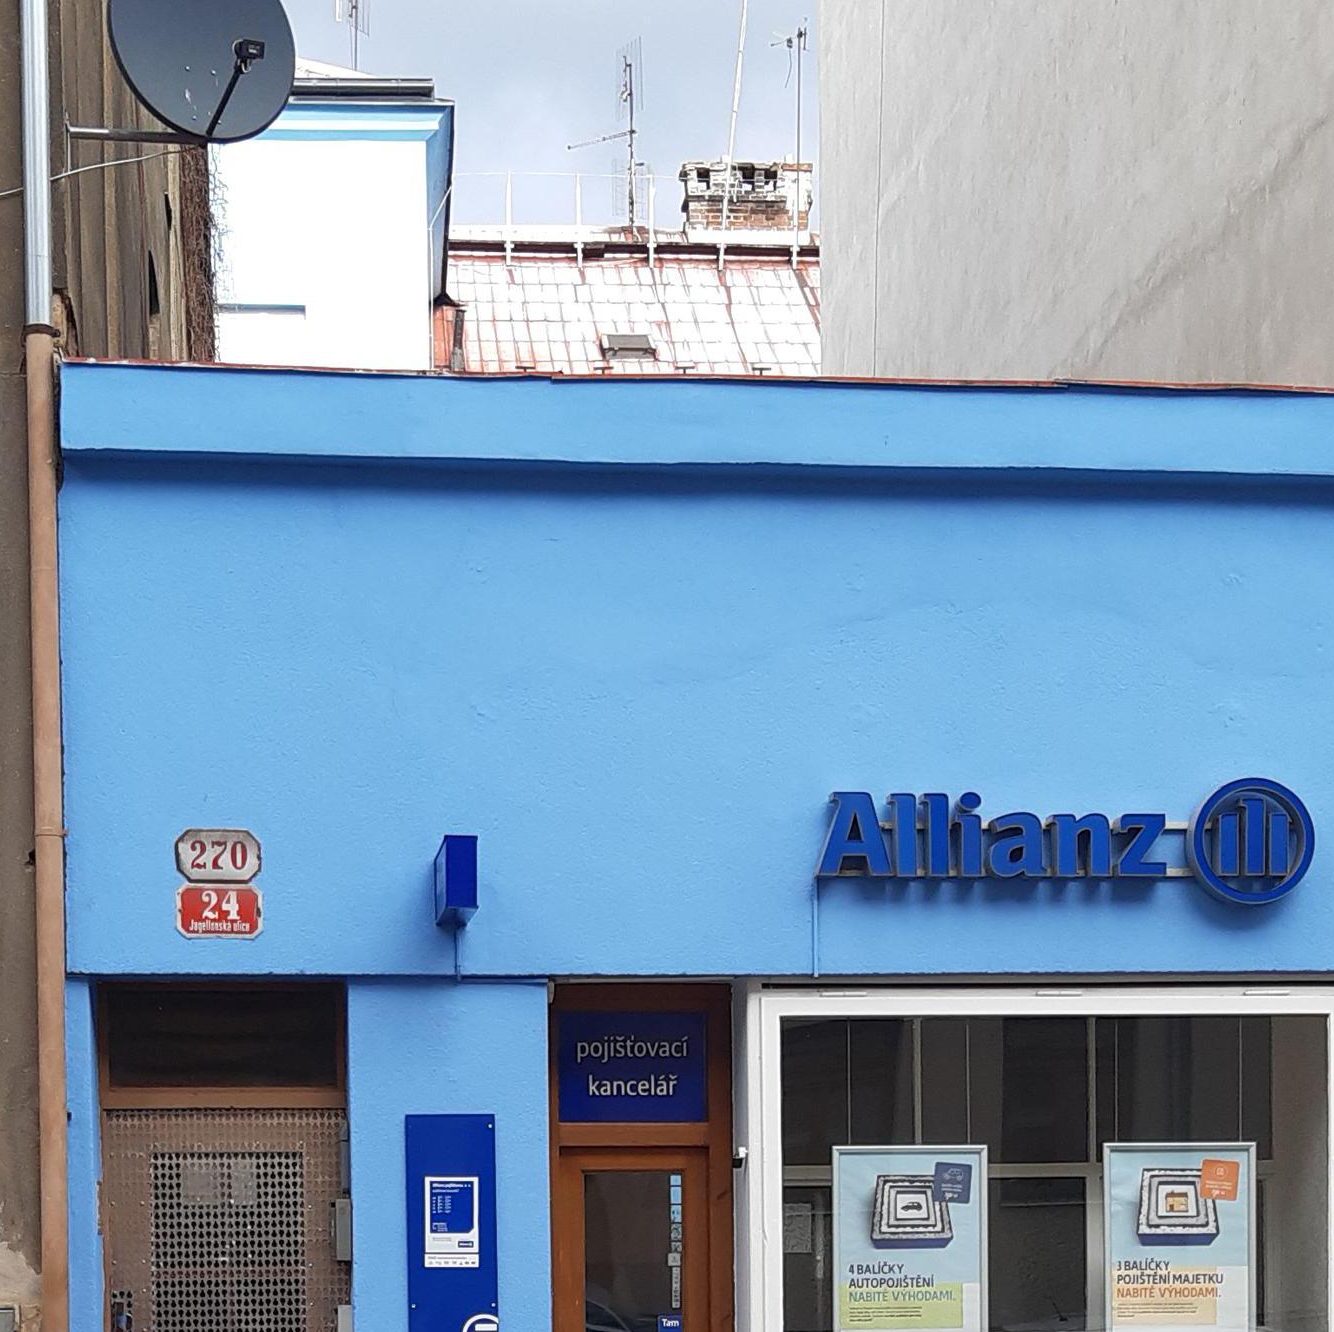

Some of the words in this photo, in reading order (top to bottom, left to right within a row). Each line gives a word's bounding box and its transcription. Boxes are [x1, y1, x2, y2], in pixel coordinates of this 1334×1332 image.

[816, 791, 1167, 877] Allianz
[190, 840, 248, 870] 270
[201, 890, 241, 920] 24
[576, 1034, 688, 1063] pojišťovací
[588, 1074, 678, 1096] kancelář
[848, 1264, 855, 1275] 4
[857, 1261, 904, 1275] BALÍČKY
[1124, 1258, 1170, 1271] BALÍČKY
[848, 1274, 934, 1289] AUTOPOJIŠTĚNÍ
[1117, 1271, 1171, 1285] POJIŠTĚNÍ
[1172, 1273, 1224, 1285] MAJETKU
[849, 1289, 888, 1302] NABITÉ
[1117, 1285, 1155, 1298] NABITÉ
[661, 1318, 680, 1327] Tam
